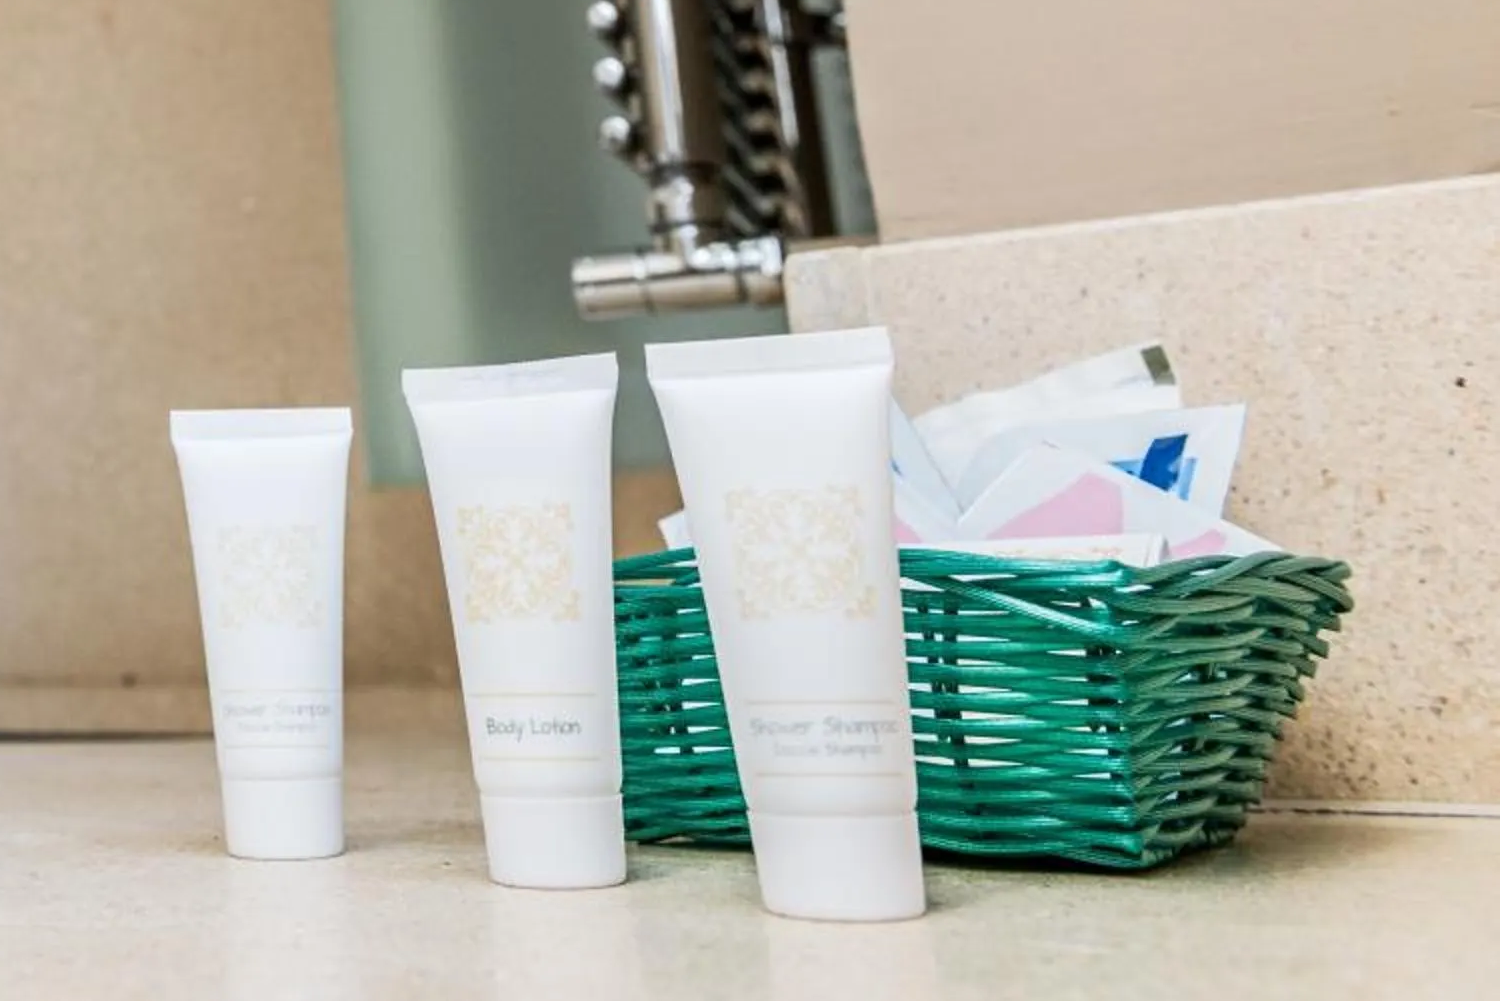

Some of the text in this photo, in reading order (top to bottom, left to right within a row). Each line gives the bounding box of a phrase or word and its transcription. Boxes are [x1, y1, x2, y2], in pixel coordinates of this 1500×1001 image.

[485, 714, 582, 743] Body Lotion
[749, 716, 815, 737] Shower
